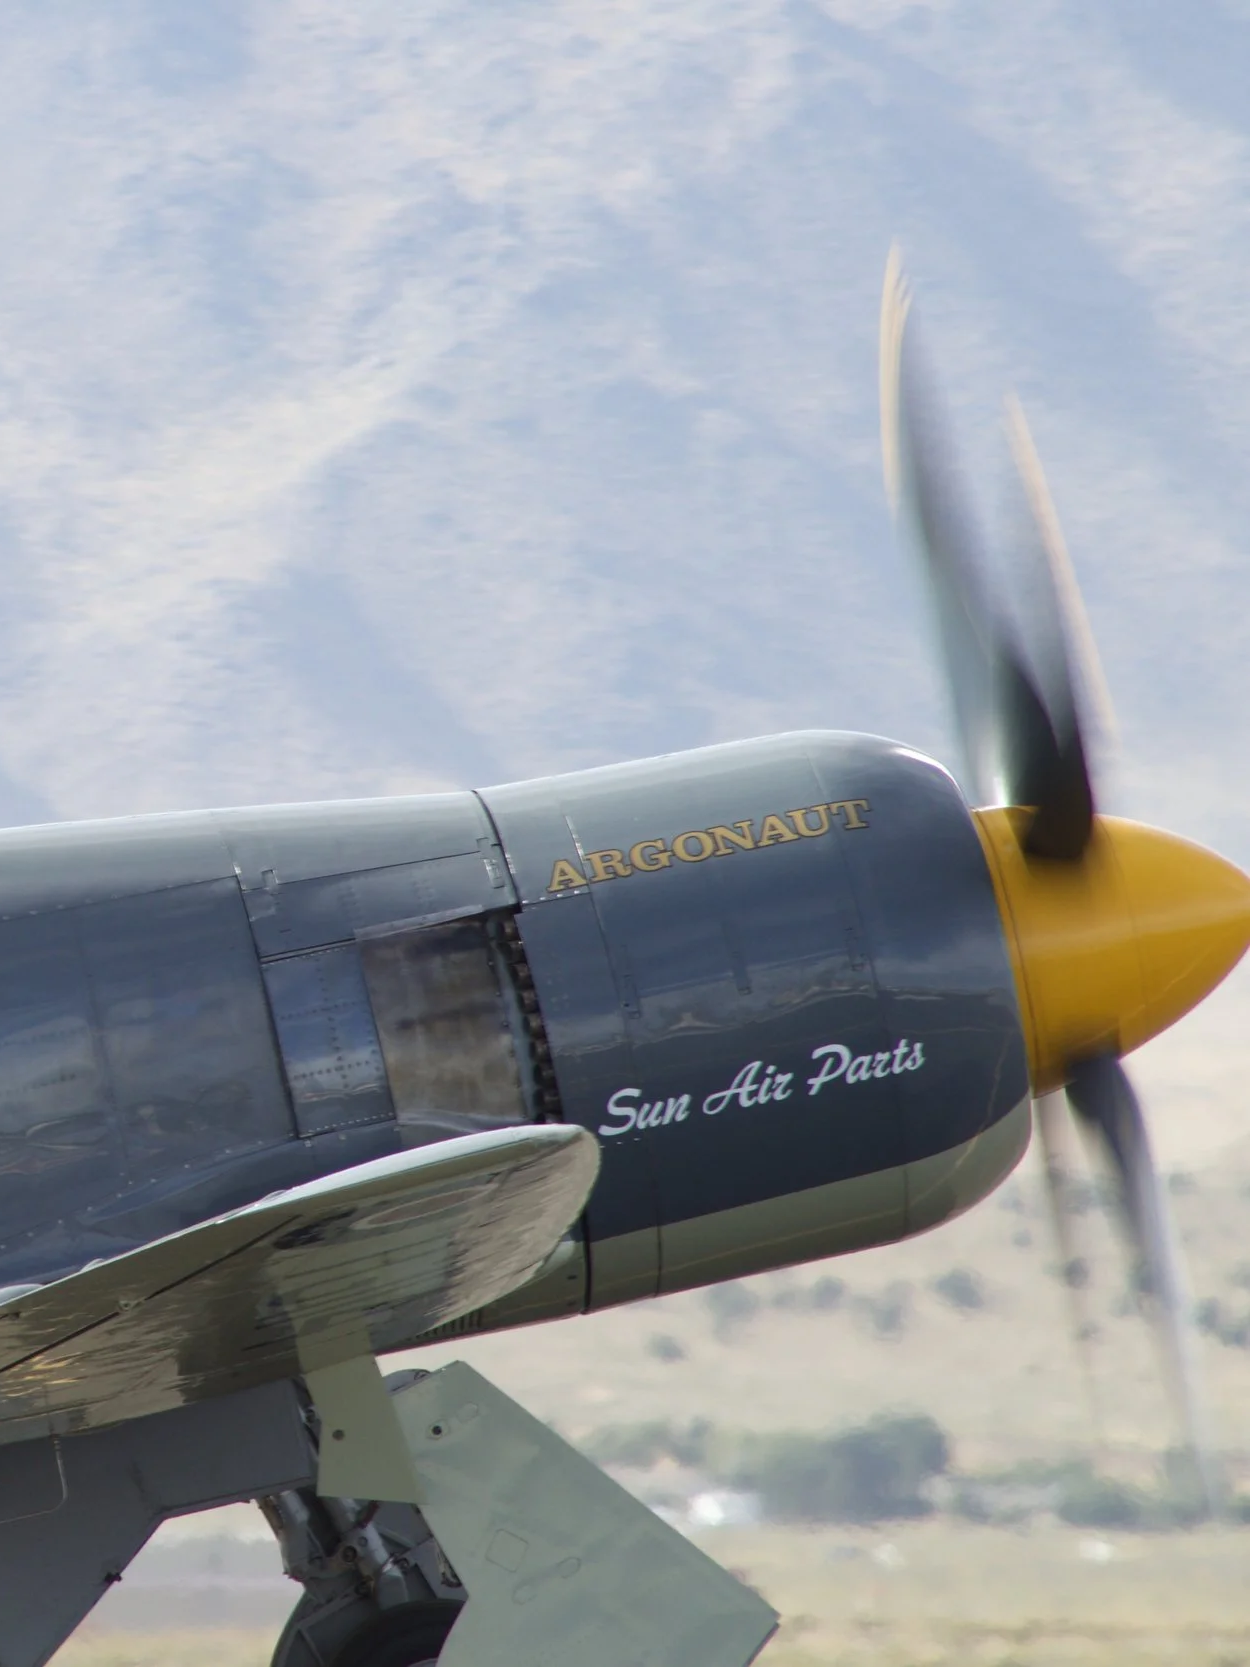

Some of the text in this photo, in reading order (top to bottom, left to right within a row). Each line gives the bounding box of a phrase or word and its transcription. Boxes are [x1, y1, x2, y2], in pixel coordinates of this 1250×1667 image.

[547, 798, 872, 892] ARGONAUT
[599, 1038, 926, 1137] Sun Air Parts
